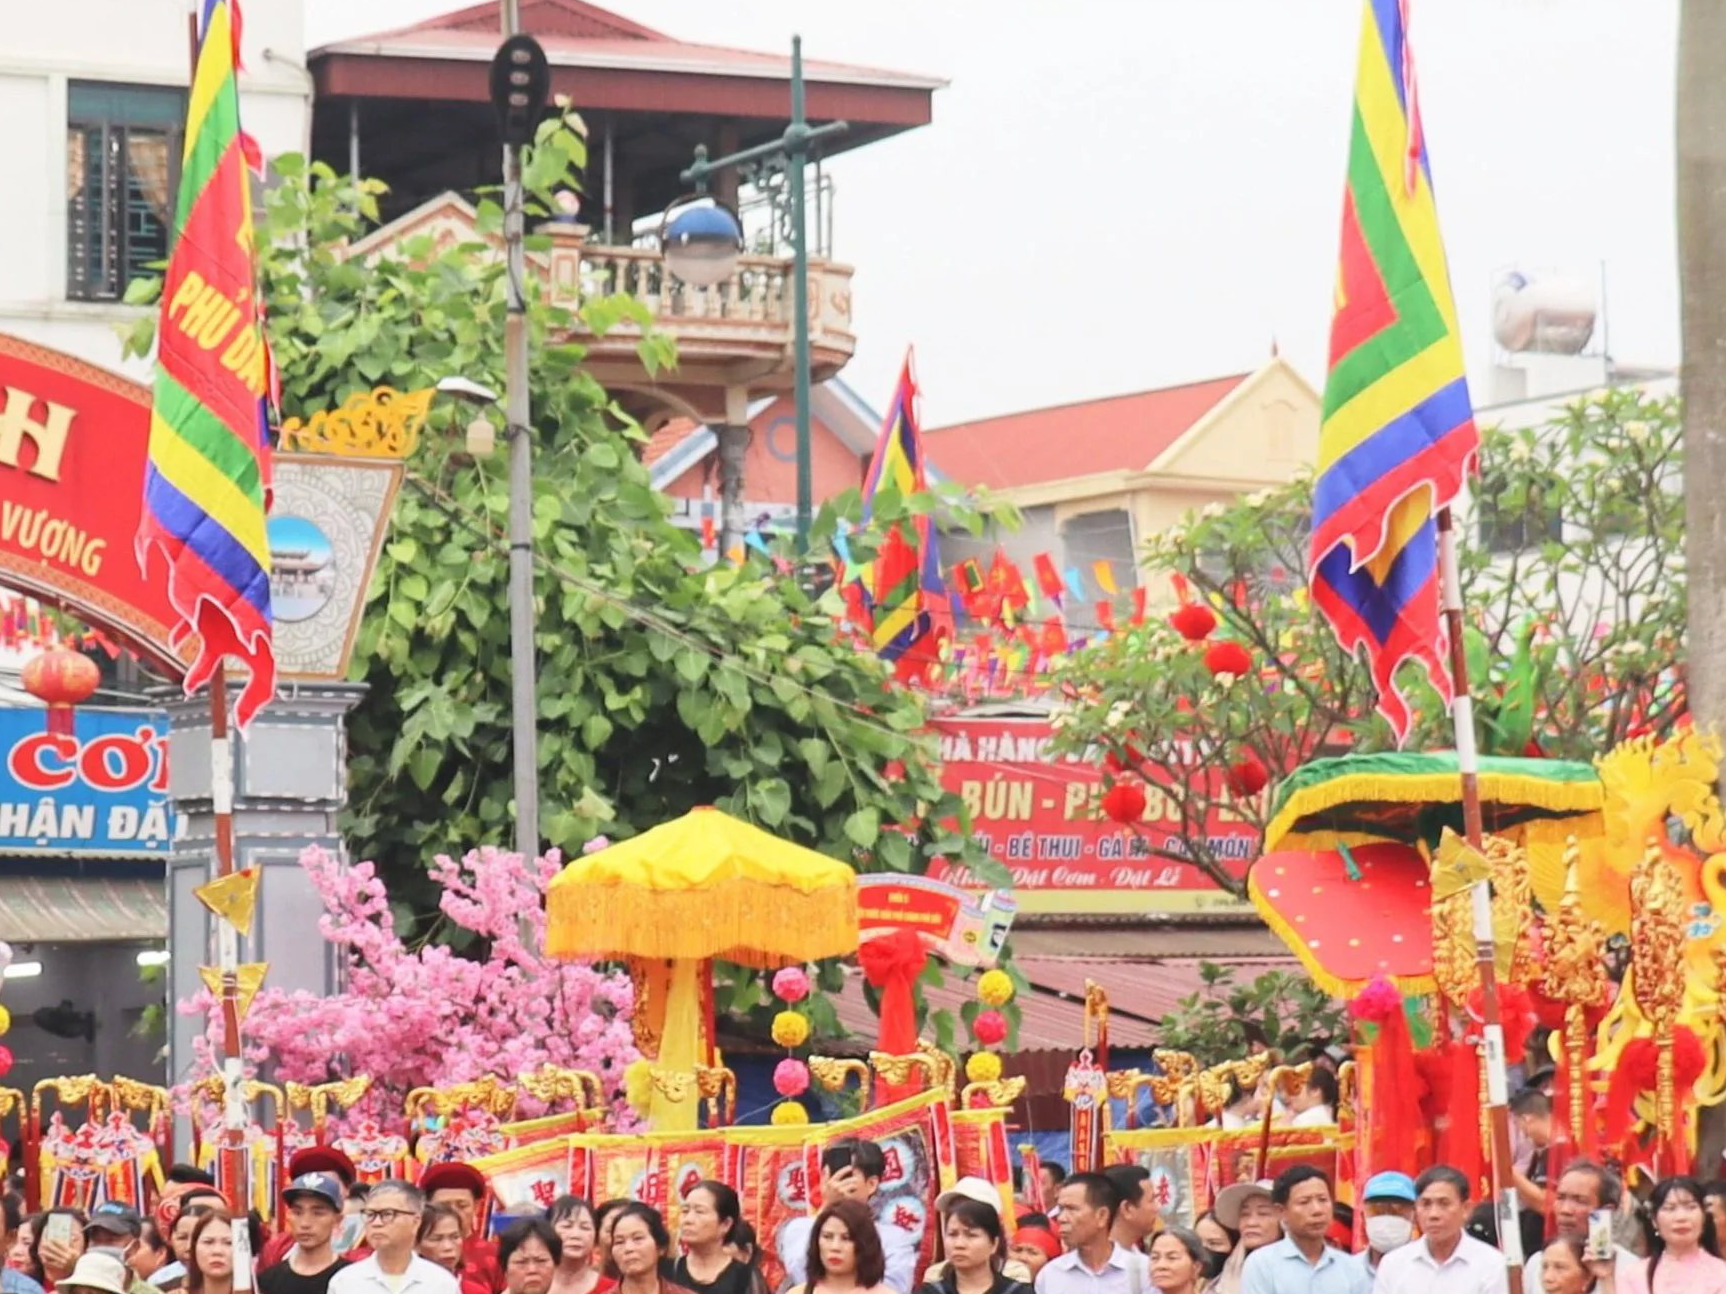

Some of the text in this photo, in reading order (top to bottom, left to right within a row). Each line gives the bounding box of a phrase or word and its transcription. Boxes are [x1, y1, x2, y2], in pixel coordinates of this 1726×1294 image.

[168, 270, 248, 351] PHỦ
[0, 506, 106, 576] VƯỢNG
[962, 772, 1033, 821] BÚN
[108, 801, 169, 849] ĐẶ
[1007, 830, 1034, 858] BÊ
[1037, 836, 1081, 858] THUI
